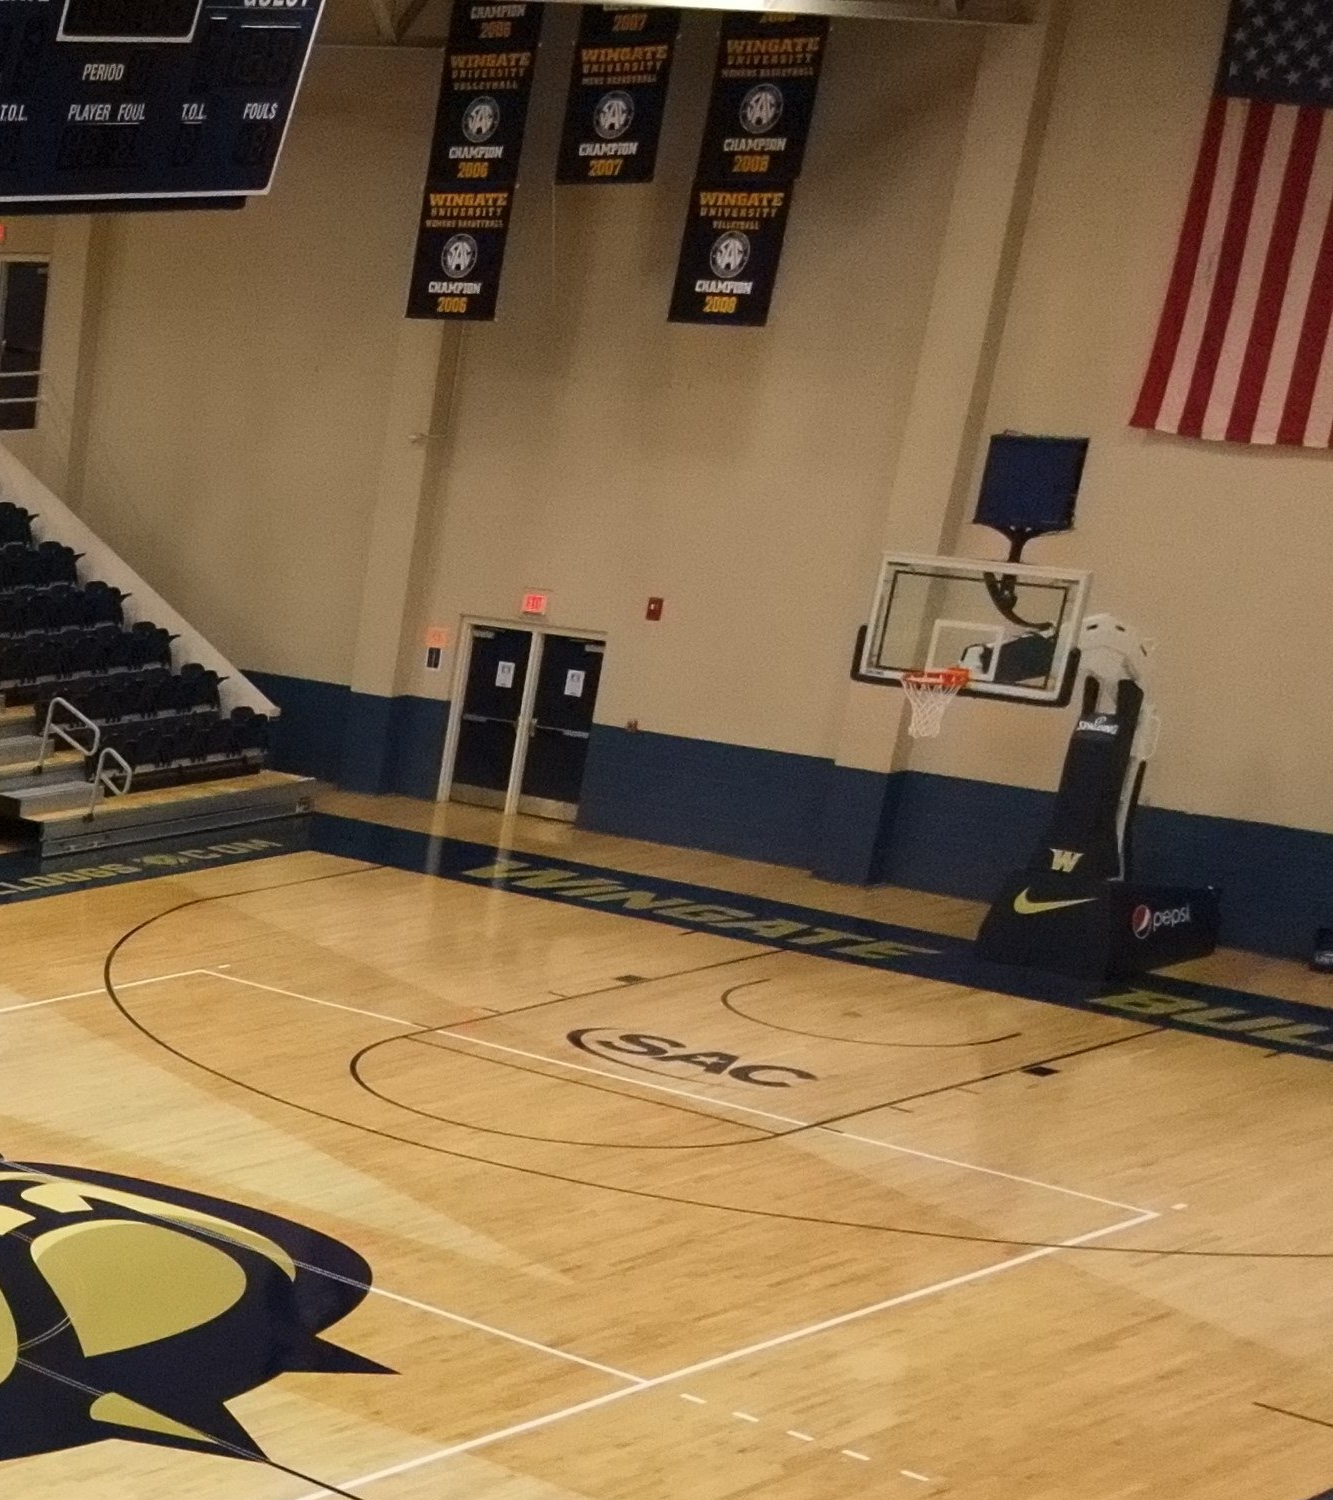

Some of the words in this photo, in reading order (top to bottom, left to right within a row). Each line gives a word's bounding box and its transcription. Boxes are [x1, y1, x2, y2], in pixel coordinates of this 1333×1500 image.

[581, 45, 668, 62] WINGATE
[727, 37, 820, 54] WINGATE
[450, 52, 532, 68] WINGATE
[82, 64, 125, 81] PERIOD
[68, 104, 111, 122] PLAYER
[118, 103, 146, 121] FOUL
[243, 103, 278, 121] FOULS
[449, 146, 504, 159] CHAMPION
[579, 142, 639, 157] CHAMPION
[723, 138, 787, 152] CHAMPION
[587, 159, 624, 177] 2007
[429, 193, 508, 206] WINGATE
[699, 191, 784, 206] WINGATE
[428, 281, 482, 294] CHAMPION
[695, 279, 753, 294] CHAMPION
[1049, 848, 1084, 873] W
[461, 860, 942, 960] WINGATE
[1153, 903, 1192, 933] pepsi
[599, 1032, 818, 1088] SAC
